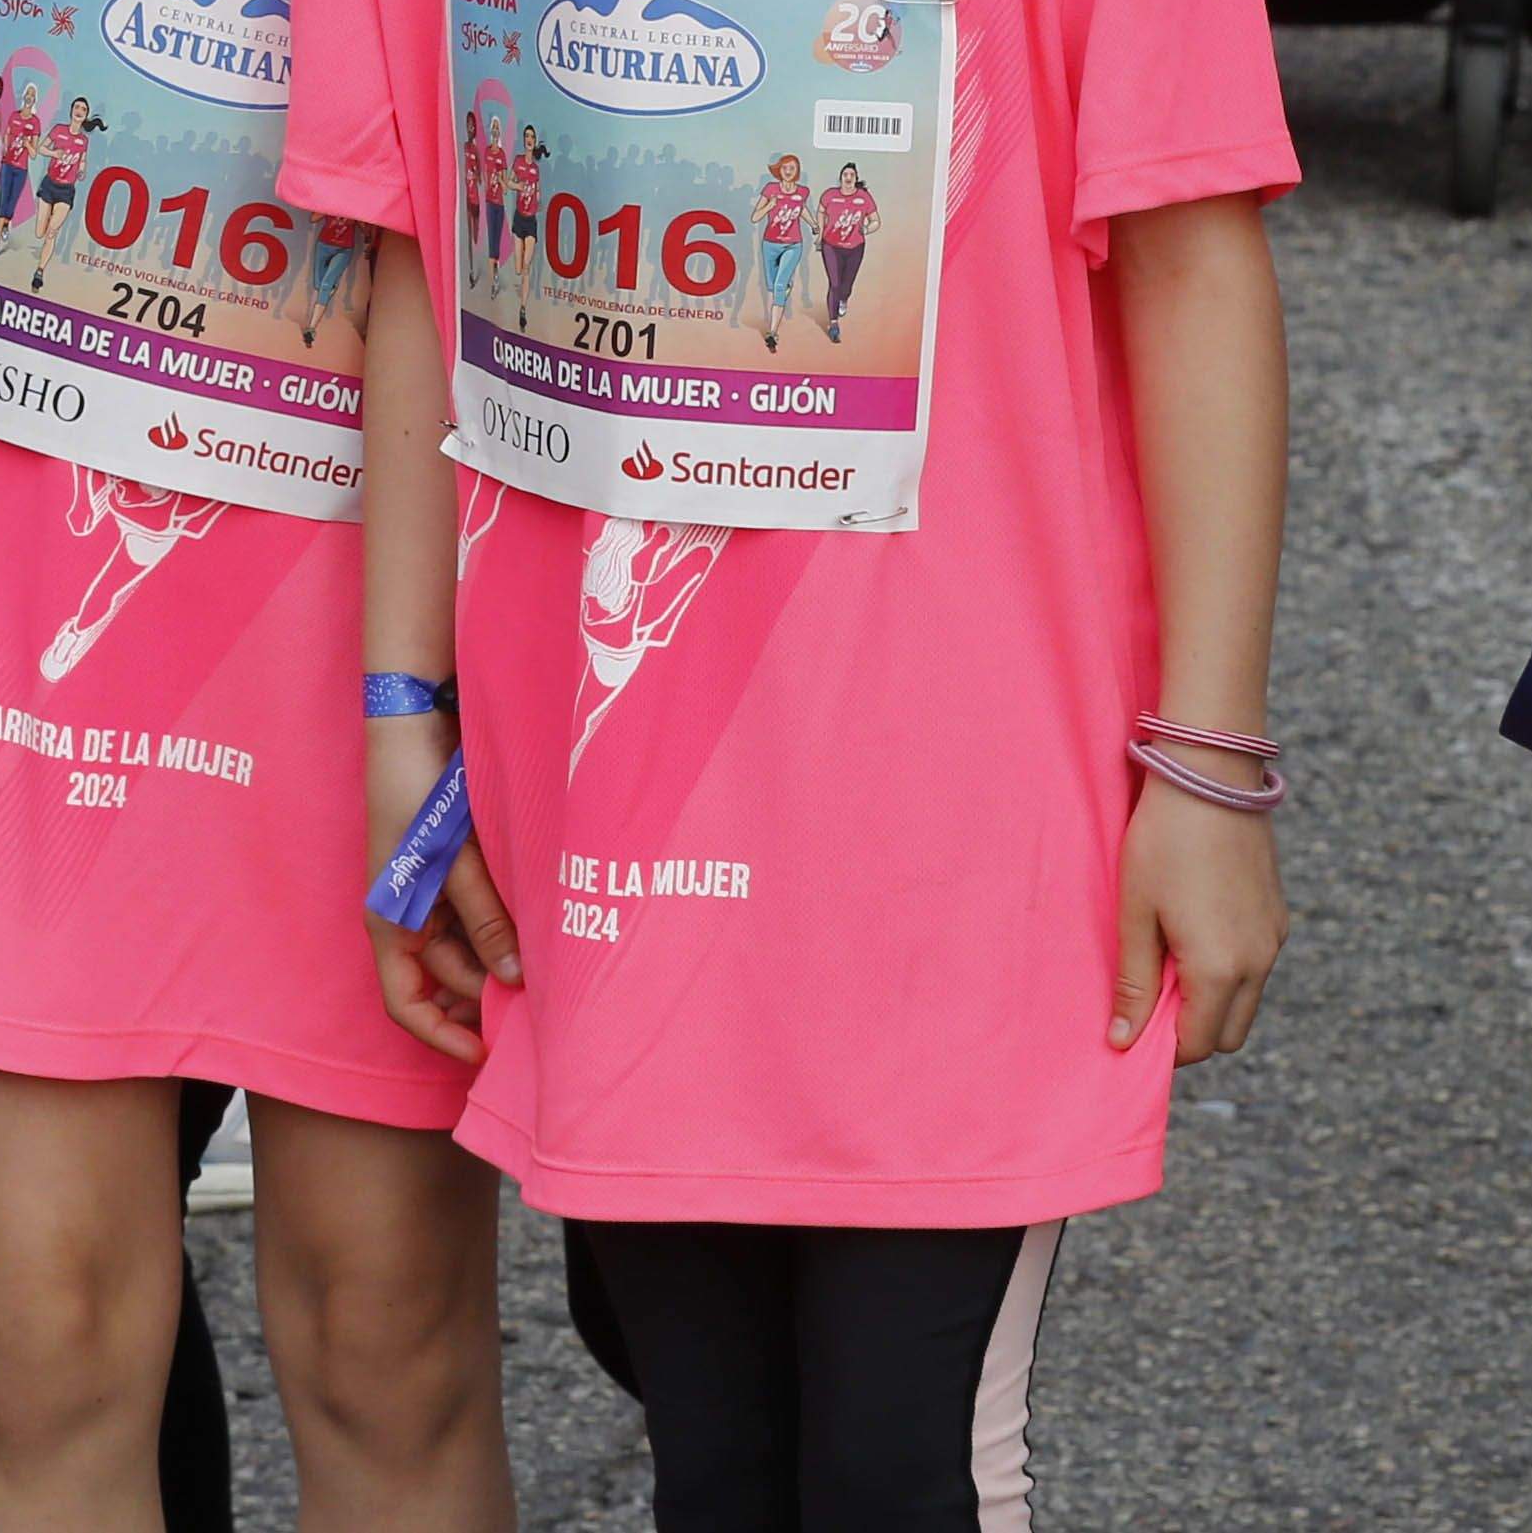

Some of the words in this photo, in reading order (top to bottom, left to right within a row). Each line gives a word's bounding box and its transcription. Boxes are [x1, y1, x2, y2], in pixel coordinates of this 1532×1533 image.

[159, 6, 235, 35] CENTRAL
[243, 28, 291, 47] LECH
[461, 22, 497, 54] gijón
[570, 20, 639, 42] CENTRAL
[648, 31, 736, 49] LECHERA
[545, 19, 744, 88] ASTURIANA
[84, 166, 294, 285] 016
[545, 191, 736, 296] 016
[134, 271, 196, 294] VIOLENCIA
[200, 287, 216, 299] DE
[588, 297, 644, 314] VIOLENCIA
[648, 306, 665, 316] DE
[107, 282, 207, 338] 2704
[574, 312, 656, 359] 2701
[80, 326, 115, 357] DE
[119, 337, 149, 368] LA
[160, 347, 253, 392] MUJER
[280, 376, 361, 415] GIJÓN
[558, 359, 582, 390] DE
[587, 367, 612, 399] LA
[621, 374, 720, 408] MUJER
[750, 375, 835, 415] GIJÓN
[483, 396, 570, 464] OYSHO
[194, 429, 363, 488] Santander
[671, 452, 855, 491] Santander
[82, 727, 116, 763] DE
[120, 731, 149, 766] LA
[157, 735, 254, 786] MUJER
[66, 772, 127, 808] 2024
[570, 854, 599, 893] DE
[607, 861, 643, 897] LA
[651, 860, 750, 898] MUJER
[562, 899, 619, 942] 2024
